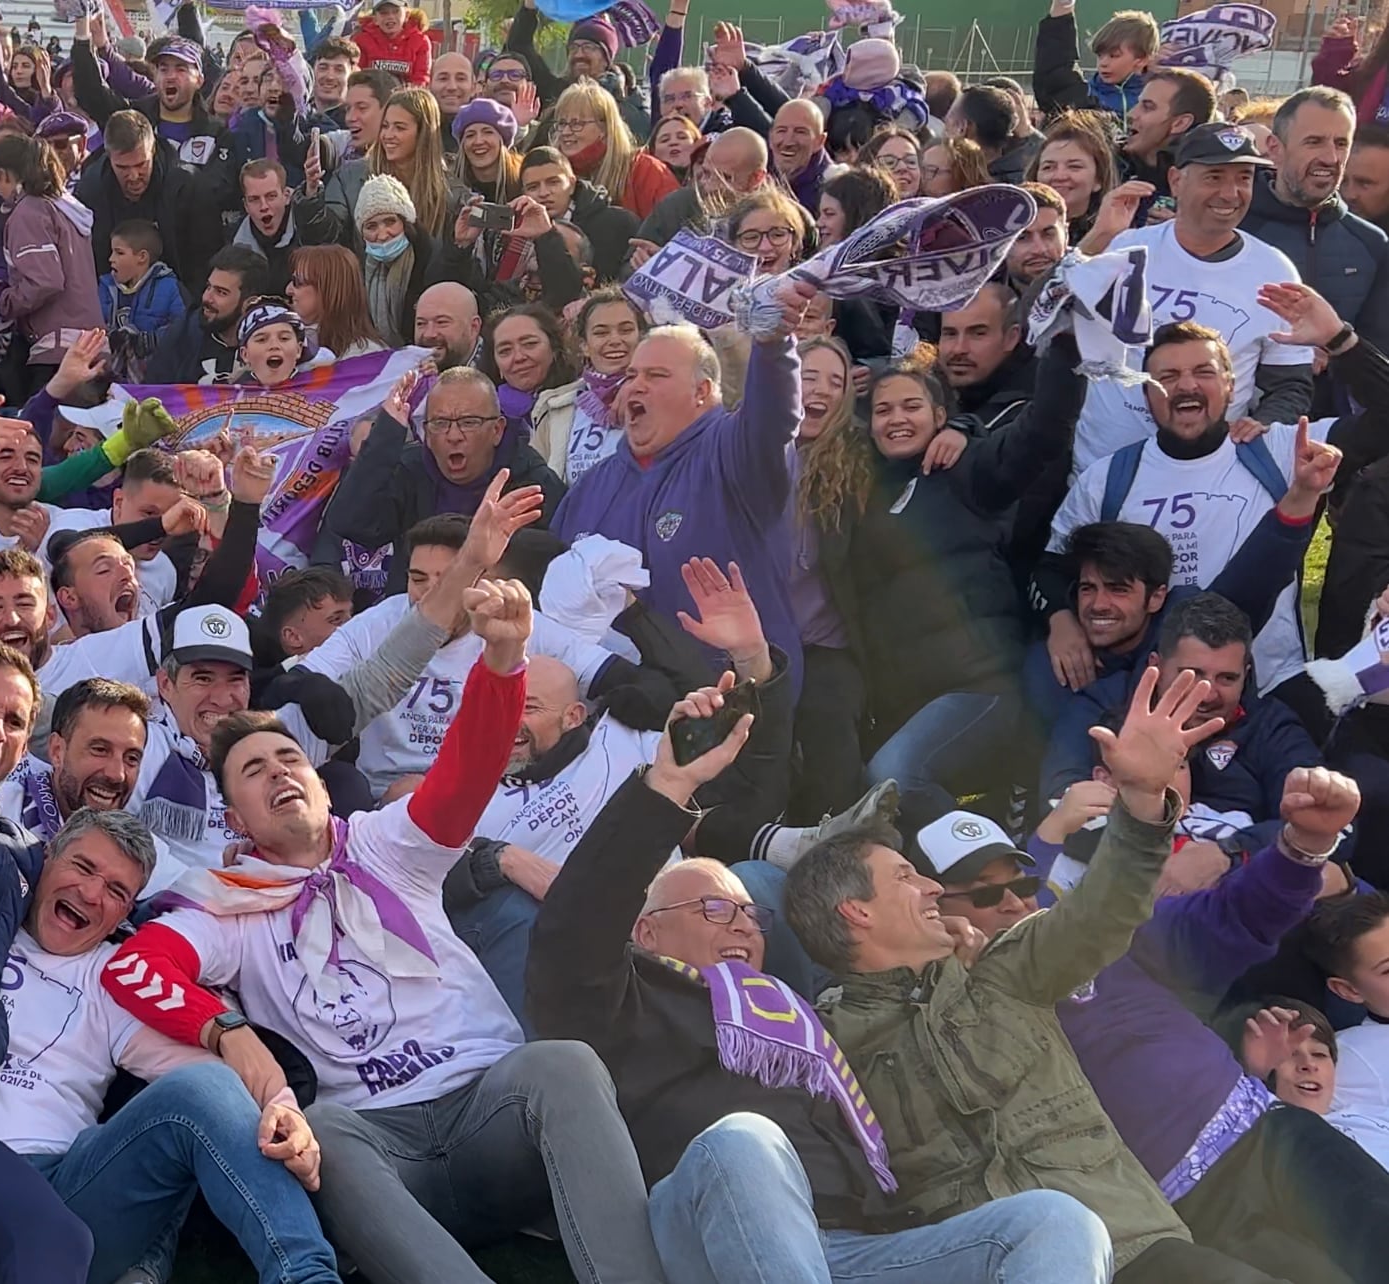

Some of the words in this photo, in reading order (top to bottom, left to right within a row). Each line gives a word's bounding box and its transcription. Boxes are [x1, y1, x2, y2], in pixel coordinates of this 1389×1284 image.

[1151, 284, 1199, 322] 75
[1142, 492, 1196, 529] 75
[1171, 531, 1197, 542] PARA
[1172, 553, 1199, 563] POR
[1184, 576, 1198, 586] PE
[406, 677, 454, 713] 75
[422, 745, 439, 755] CA
[524, 803, 546, 819] VER
[557, 783, 571, 797] MI
[550, 803, 580, 829] CAM
[29, 1070, 43, 1082] DE
